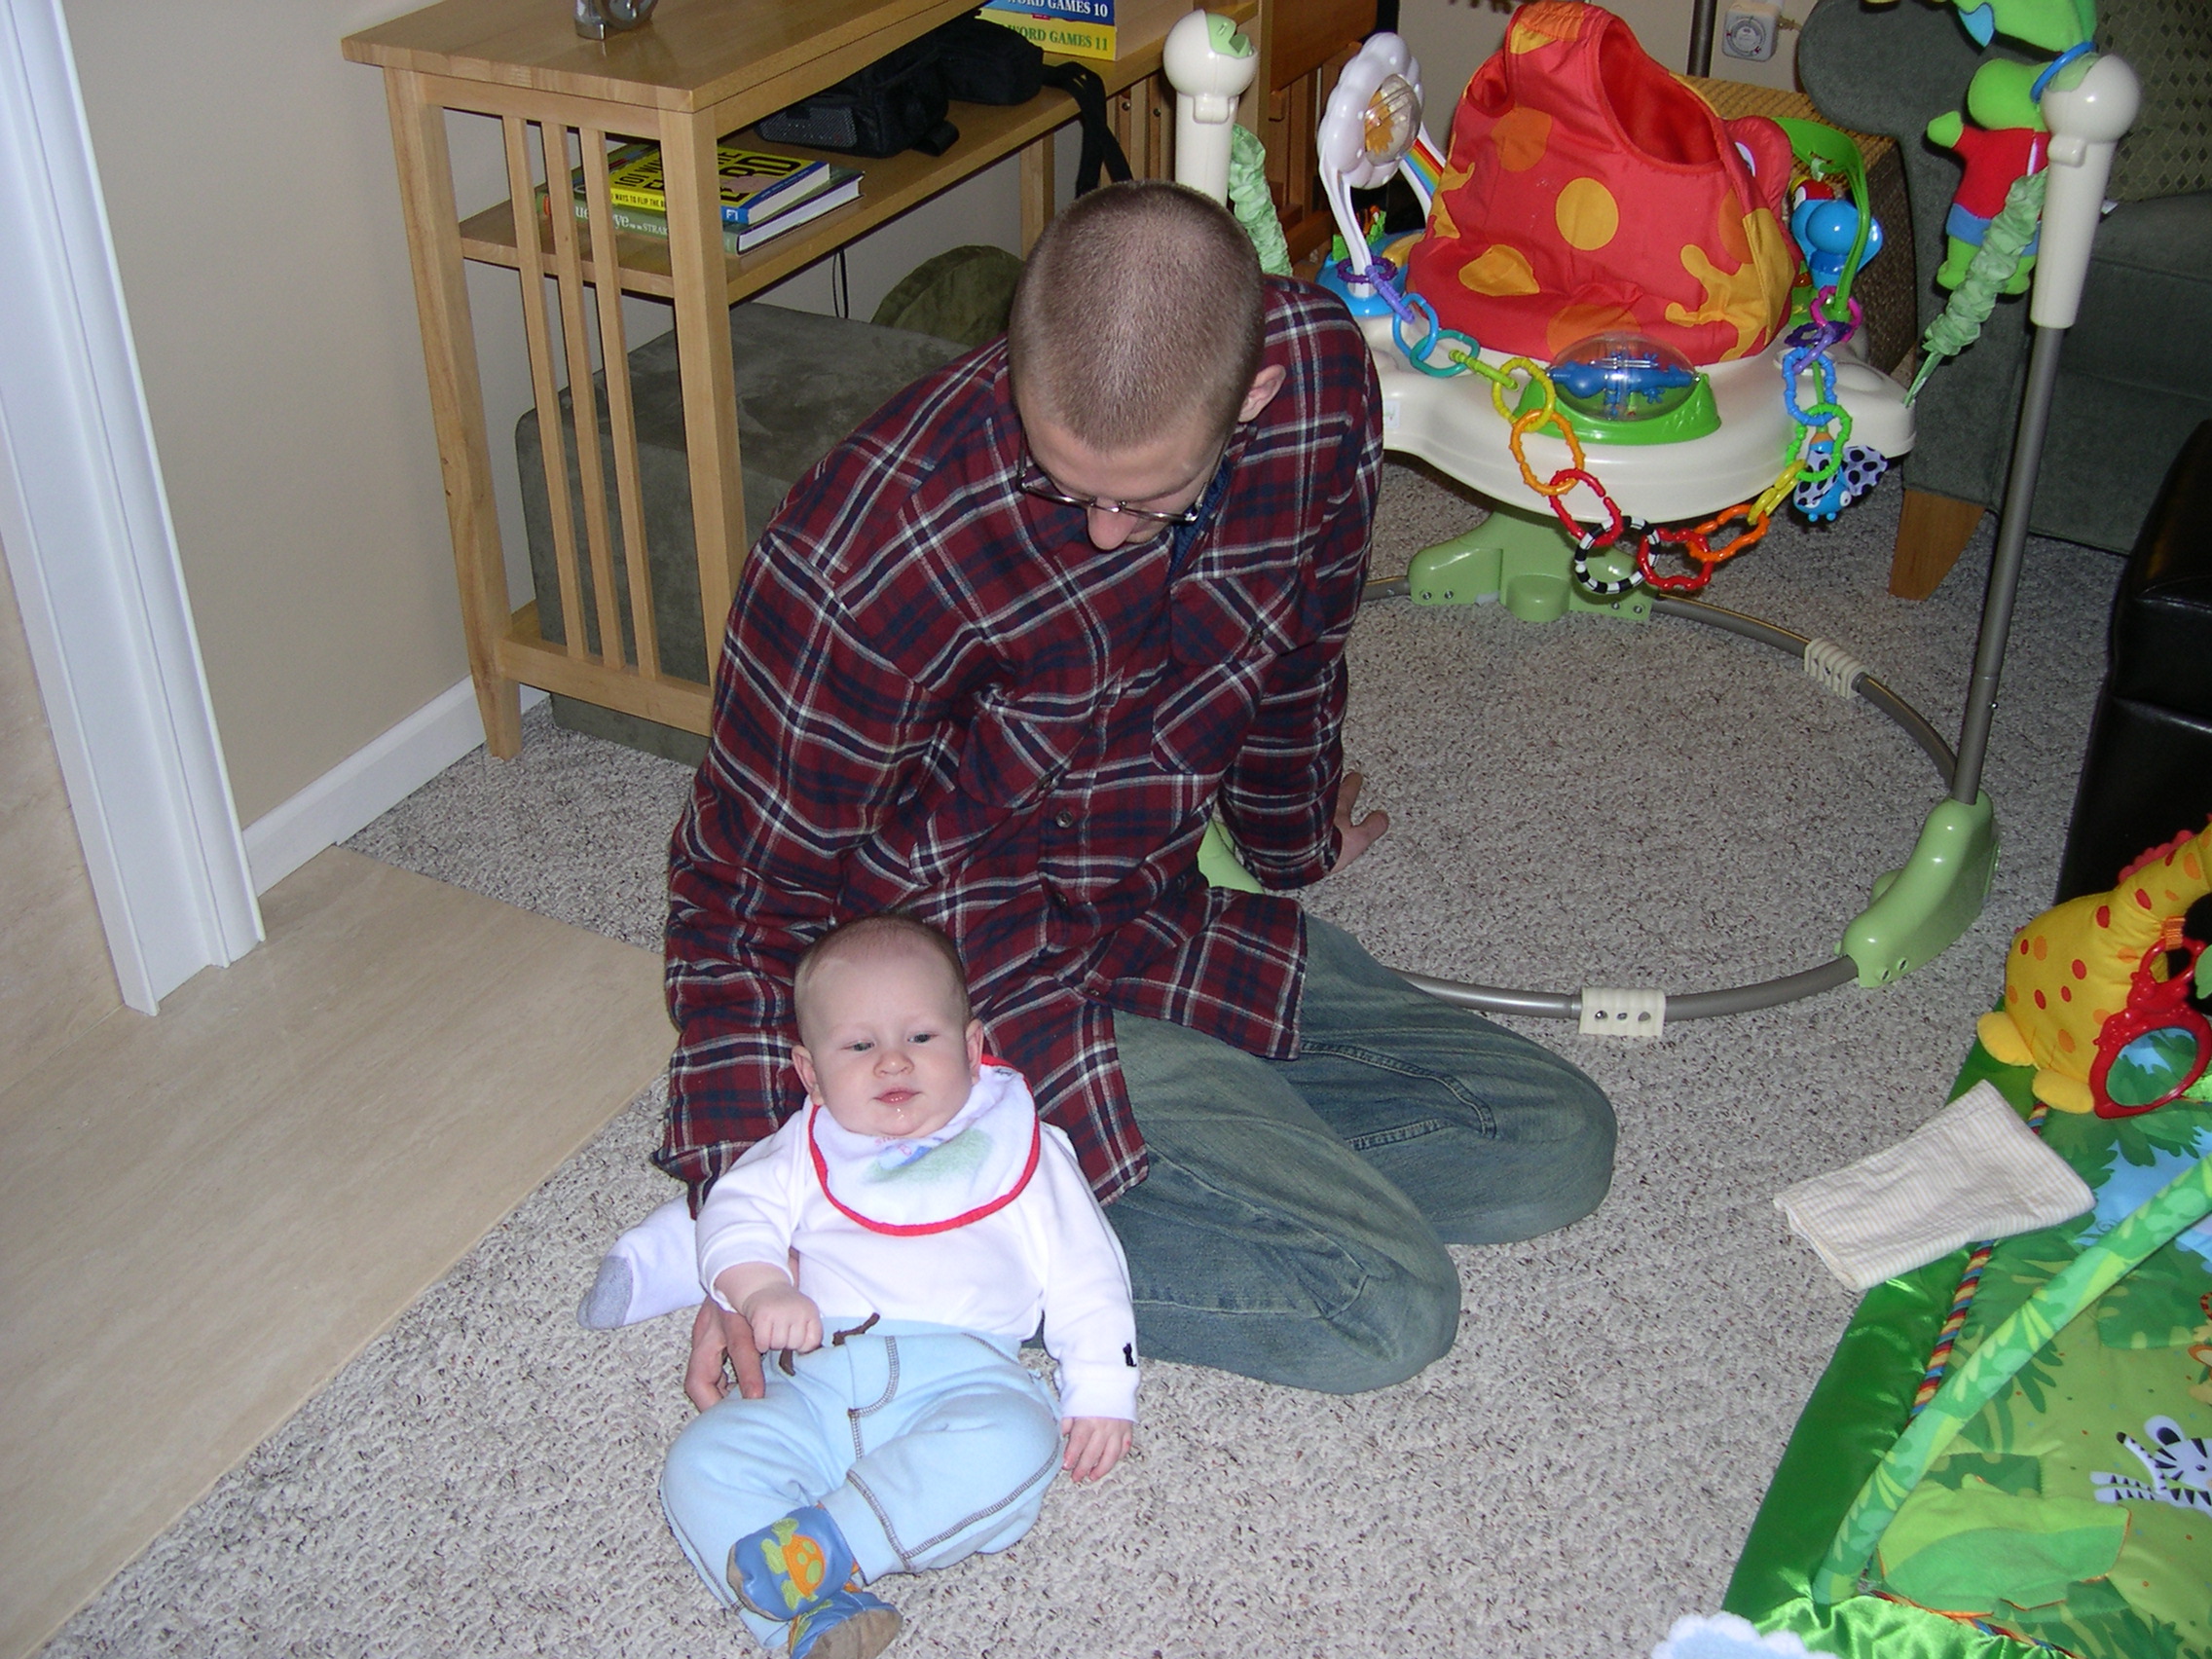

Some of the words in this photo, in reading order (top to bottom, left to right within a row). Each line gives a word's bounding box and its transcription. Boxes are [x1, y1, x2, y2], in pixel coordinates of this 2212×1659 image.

[1048, 0, 1091, 15] GAMES
[1093, 3, 1109, 18] 10
[1049, 30, 1092, 48] GAMES
[1095, 37, 1109, 52] 11
[614, 172, 649, 187] 101
[649, 198, 660, 207] THE
[611, 213, 630, 230] ye
